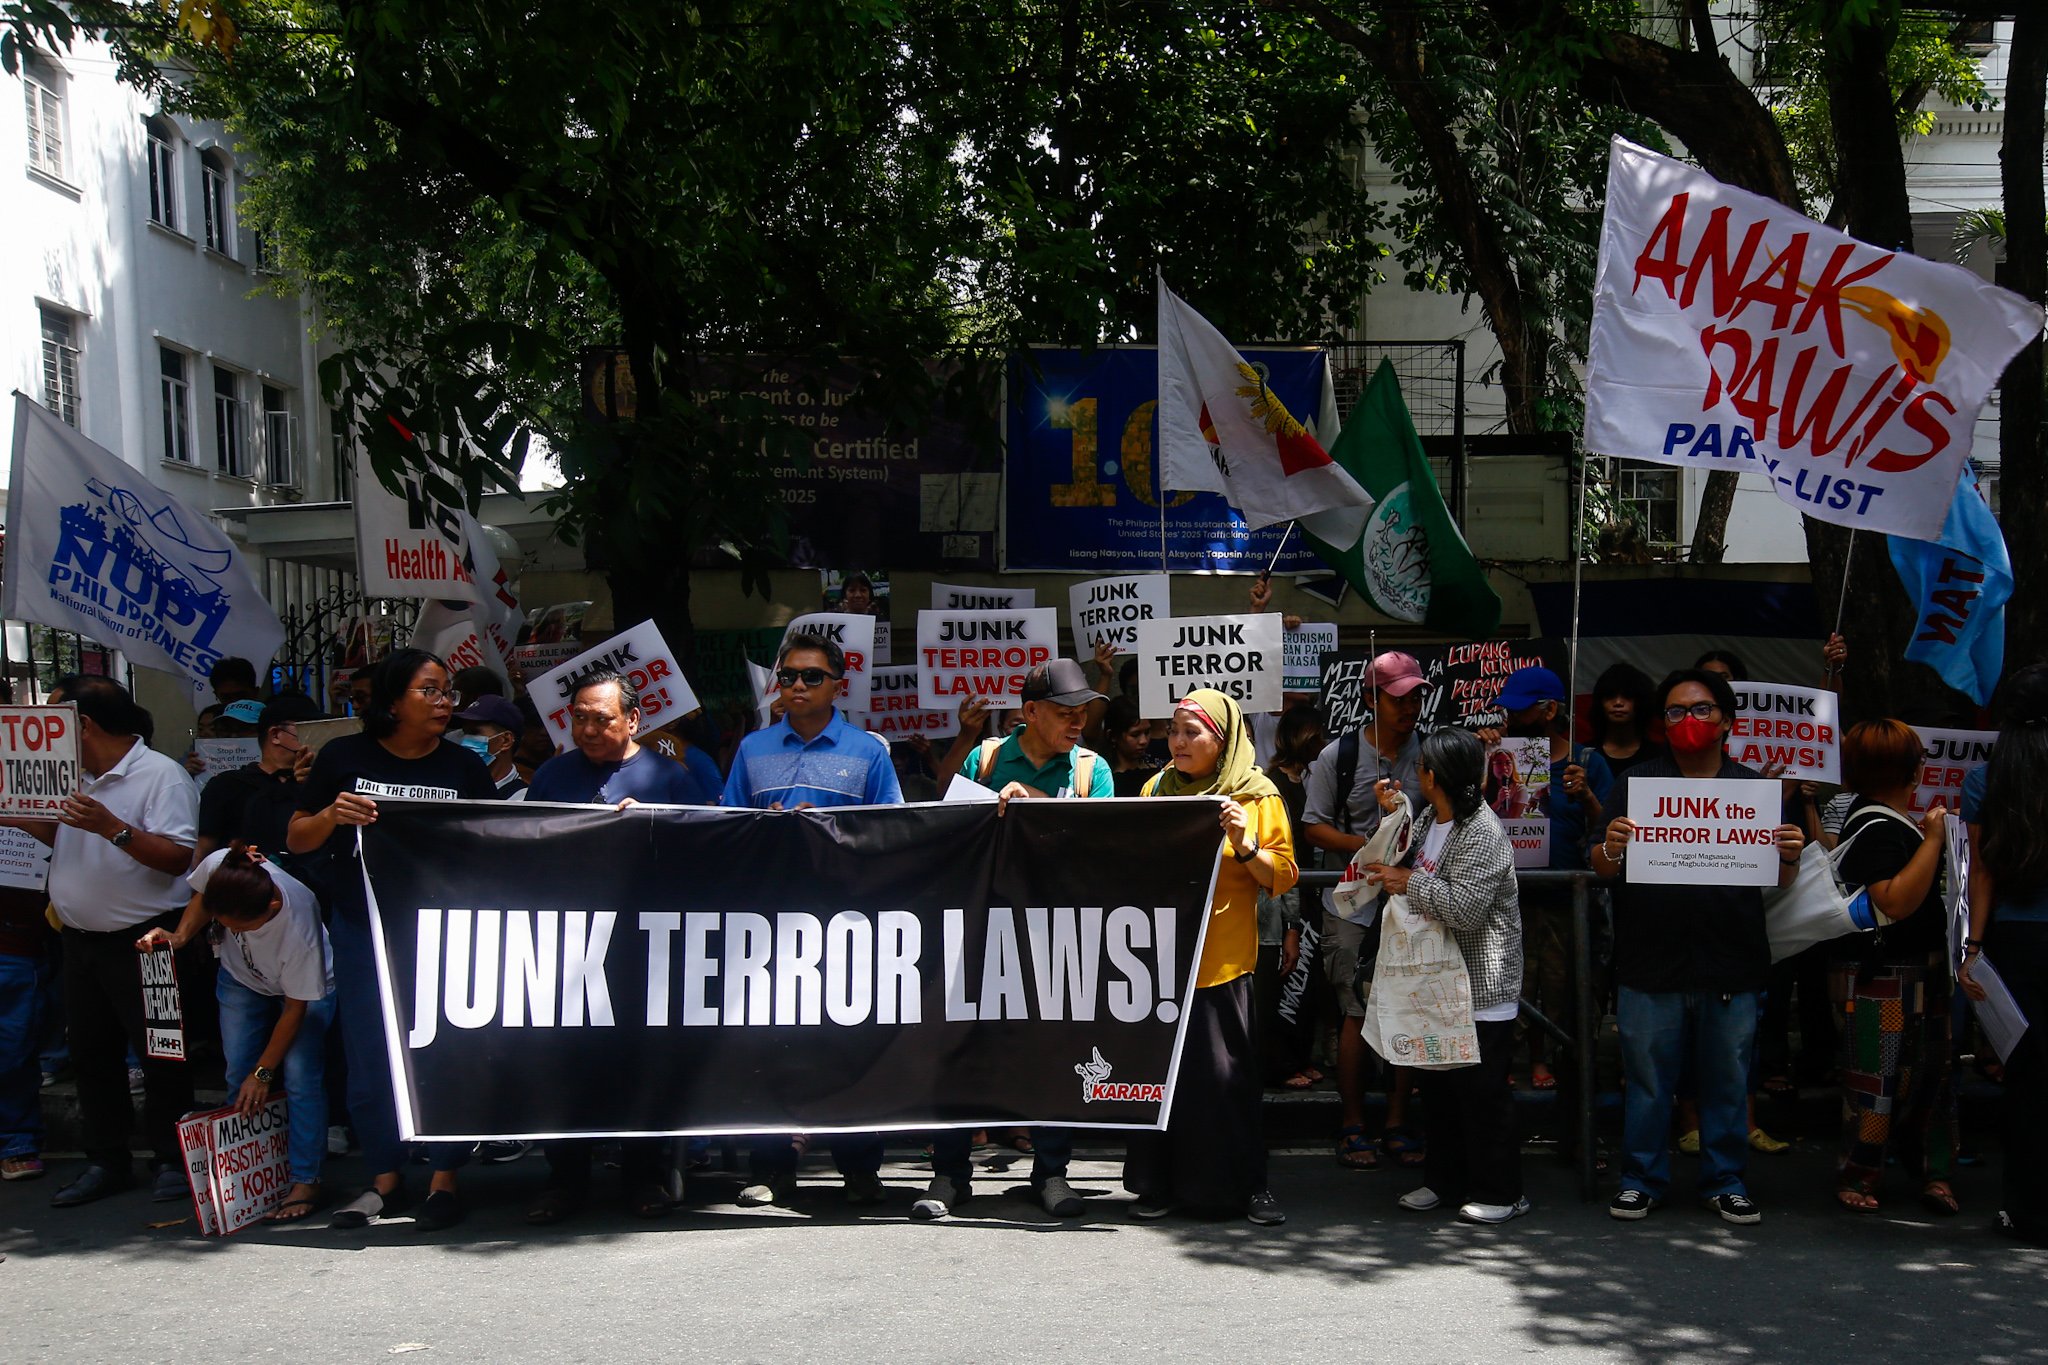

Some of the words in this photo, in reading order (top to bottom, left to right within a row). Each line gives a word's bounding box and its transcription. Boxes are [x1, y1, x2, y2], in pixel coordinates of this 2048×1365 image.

[1632, 192, 1896, 359] ANAK
[814, 436, 918, 461] Certified
[828, 465, 889, 483] System)
[1662, 422, 1884, 516] PARY-LIST
[1108, 518, 1124, 528] The
[1175, 520, 1192, 529] has
[1118, 529, 1148, 538] United
[1203, 530, 1250, 541] Trafficking
[385, 538, 447, 581] Health
[1168, 550, 1205, 560] Aksyon:
[1206, 550, 1243, 560] Tapusin
[1244, 551, 1263, 561] Ang
[948, 593, 1013, 610] JUNK
[1088, 583, 1139, 604] JUNK
[48, 563, 218, 678] PHILIPPINES
[50, 586, 97, 618] National
[127, 627, 143, 639] of
[1079, 604, 1153, 628] TERROR
[940, 620, 1027, 642] JUNK
[1174, 624, 1245, 648] JUNK
[1283, 633, 1333, 643] ERORISMO
[516, 650, 538, 658] FREE
[539, 648, 559, 657] JULIE
[521, 659, 553, 668] BALORA
[1283, 655, 1320, 667] LIKASA
[1156, 652, 1264, 677] TERROR
[870, 673, 918, 691] JUN
[1169, 679, 1254, 704] LAWS!
[1284, 678, 1301, 686] ASAN
[549, 659, 673, 730] TOR
[870, 694, 918, 713] ERR
[1733, 692, 1816, 717] JUNK
[865, 712, 949, 733] LAWS!
[1731, 718, 1833, 745] ERROR
[0, 715, 66, 752] TOP
[217, 747, 234, 756] Stop
[1724, 743, 1825, 769] LAWS!
[1926, 740, 1994, 761] JUN
[6, 759, 77, 796] TAGGING!
[357, 780, 380, 793] JAIL
[386, 785, 405, 797] THE
[409, 787, 457, 800] CORRUPT
[1653, 797, 1720, 819] JUNK
[1725, 803, 1756, 819] the
[8, 828, 34, 839] free
[1521, 826, 1545, 836] ANN
[1633, 827, 1711, 844] TERROR
[1716, 828, 1779, 845] LAWS!
[16, 841, 36, 849] and
[27, 850, 36, 859] is
[1511, 839, 1542, 849] NOW!
[1648, 860, 1677, 868] Kilusang
[1678, 860, 1719, 869] Magbubukid
[1730, 861, 1759, 869] Pilipinas
[1671, 852, 1697, 861] Tanggol
[1698, 853, 1736, 861] Magsasaka
[139, 950, 175, 985] ABOLISH
[409, 909, 618, 1049] JUNK
[639, 909, 923, 1027] TERROR
[943, 905, 1179, 1025] LAWS!
[1092, 1084, 1165, 1101] KARAPA
[219, 1103, 281, 1148] MARCOS
[217, 1139, 265, 1179] PASISTA
[224, 1182, 236, 1203] at
